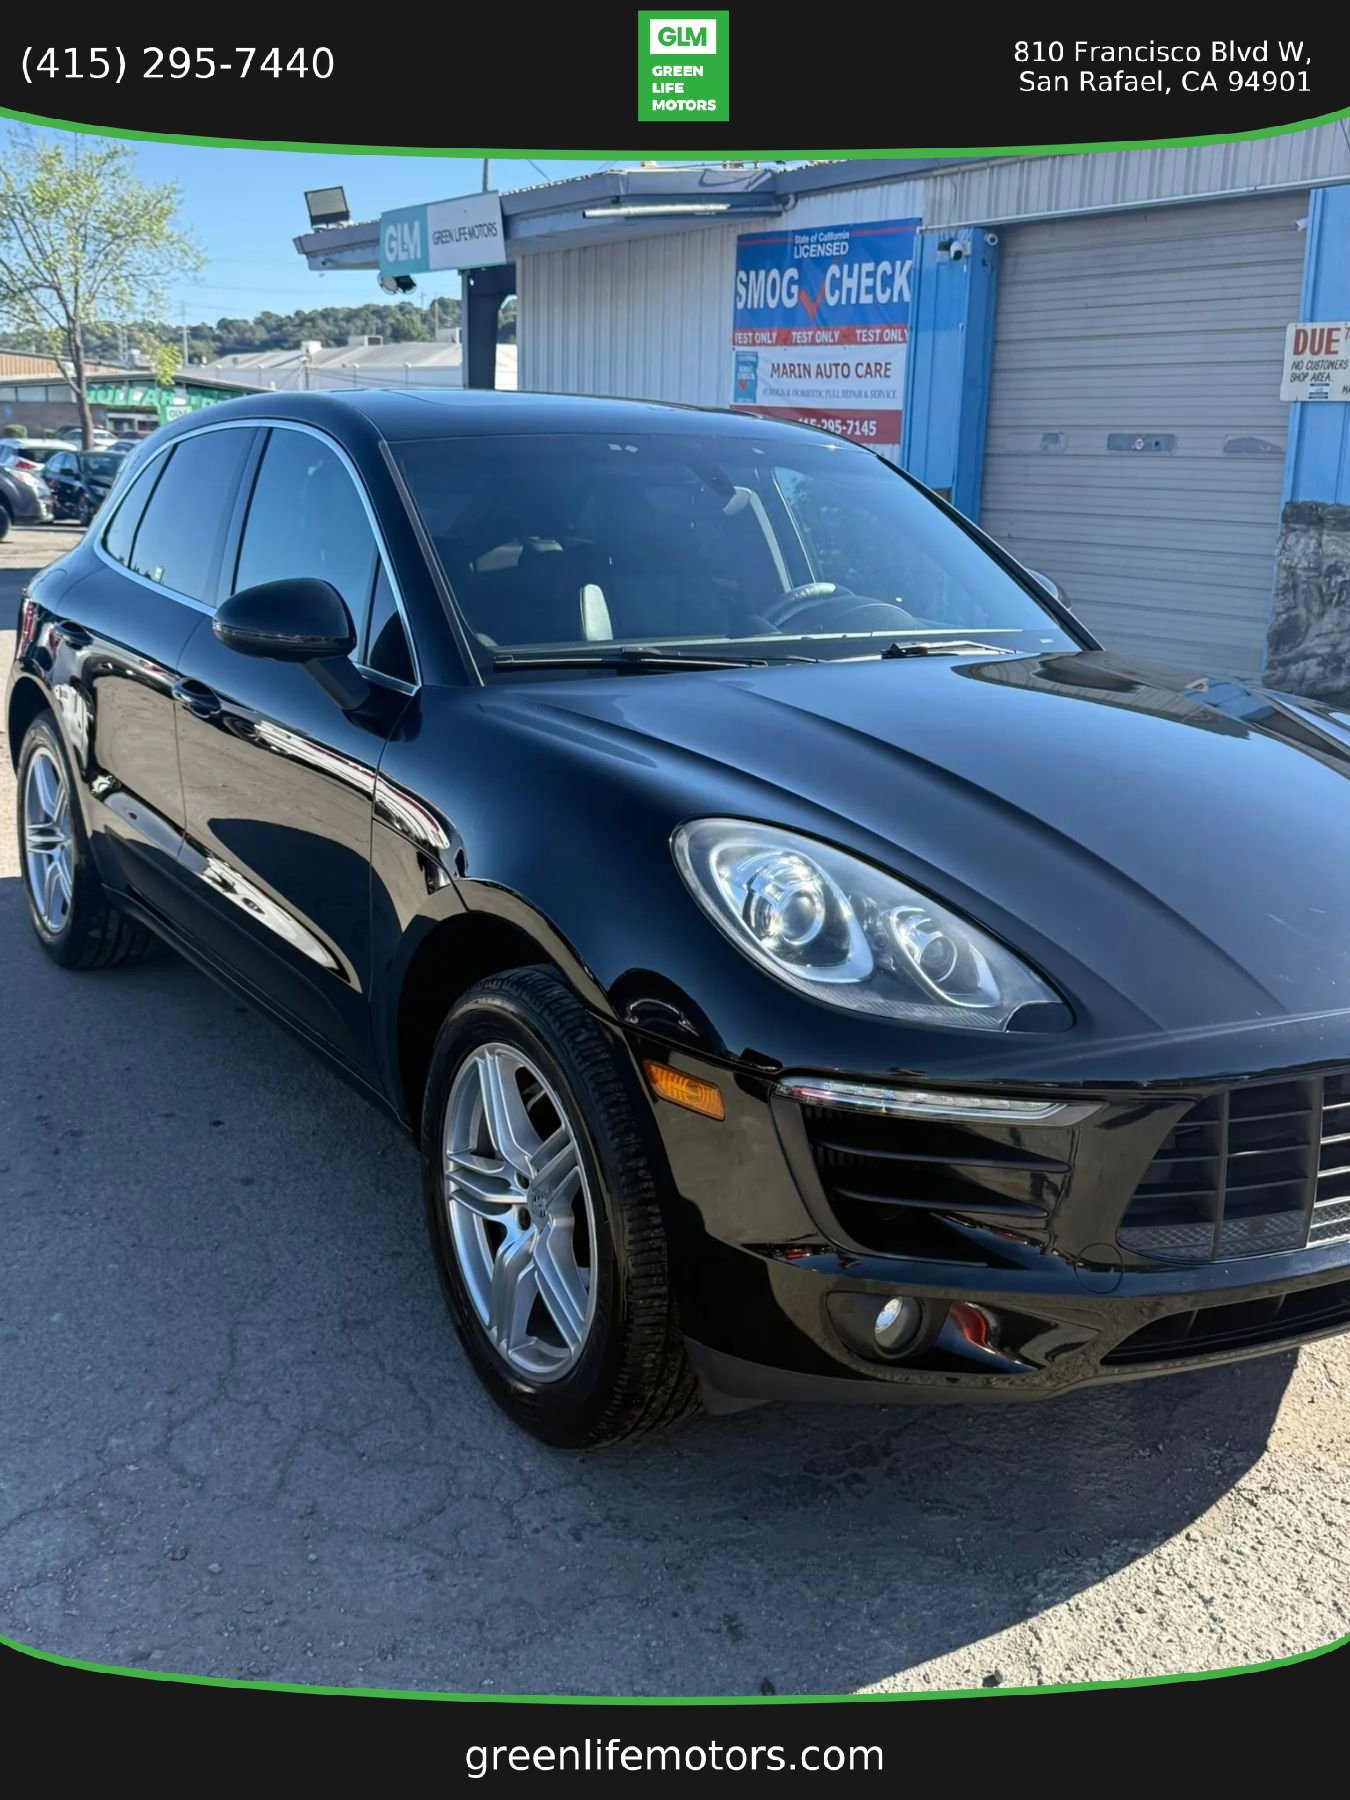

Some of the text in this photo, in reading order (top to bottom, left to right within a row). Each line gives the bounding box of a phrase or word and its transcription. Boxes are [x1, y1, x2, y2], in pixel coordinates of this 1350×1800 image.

[432, 229, 454, 245] GREEN
[468, 221, 498, 241] MOTORS
[810, 232, 818, 243] of
[819, 230, 850, 242] California
[384, 220, 421, 263] GLM
[793, 241, 849, 259] LICENSED
[736, 259, 913, 310] SMOG CHECK
[734, 331, 778, 344] TEST ONLY
[791, 330, 840, 344] TEST ONLY
[856, 328, 909, 343] TEST ONLY
[1293, 327, 1341, 356] DUE
[770, 362, 811, 379] MARIN
[815, 362, 850, 379] AUTO
[855, 362, 892, 379] CARE
[1291, 359, 1349, 371] NO CUSTOMERS
[1289, 372, 1309, 383] SHOP
